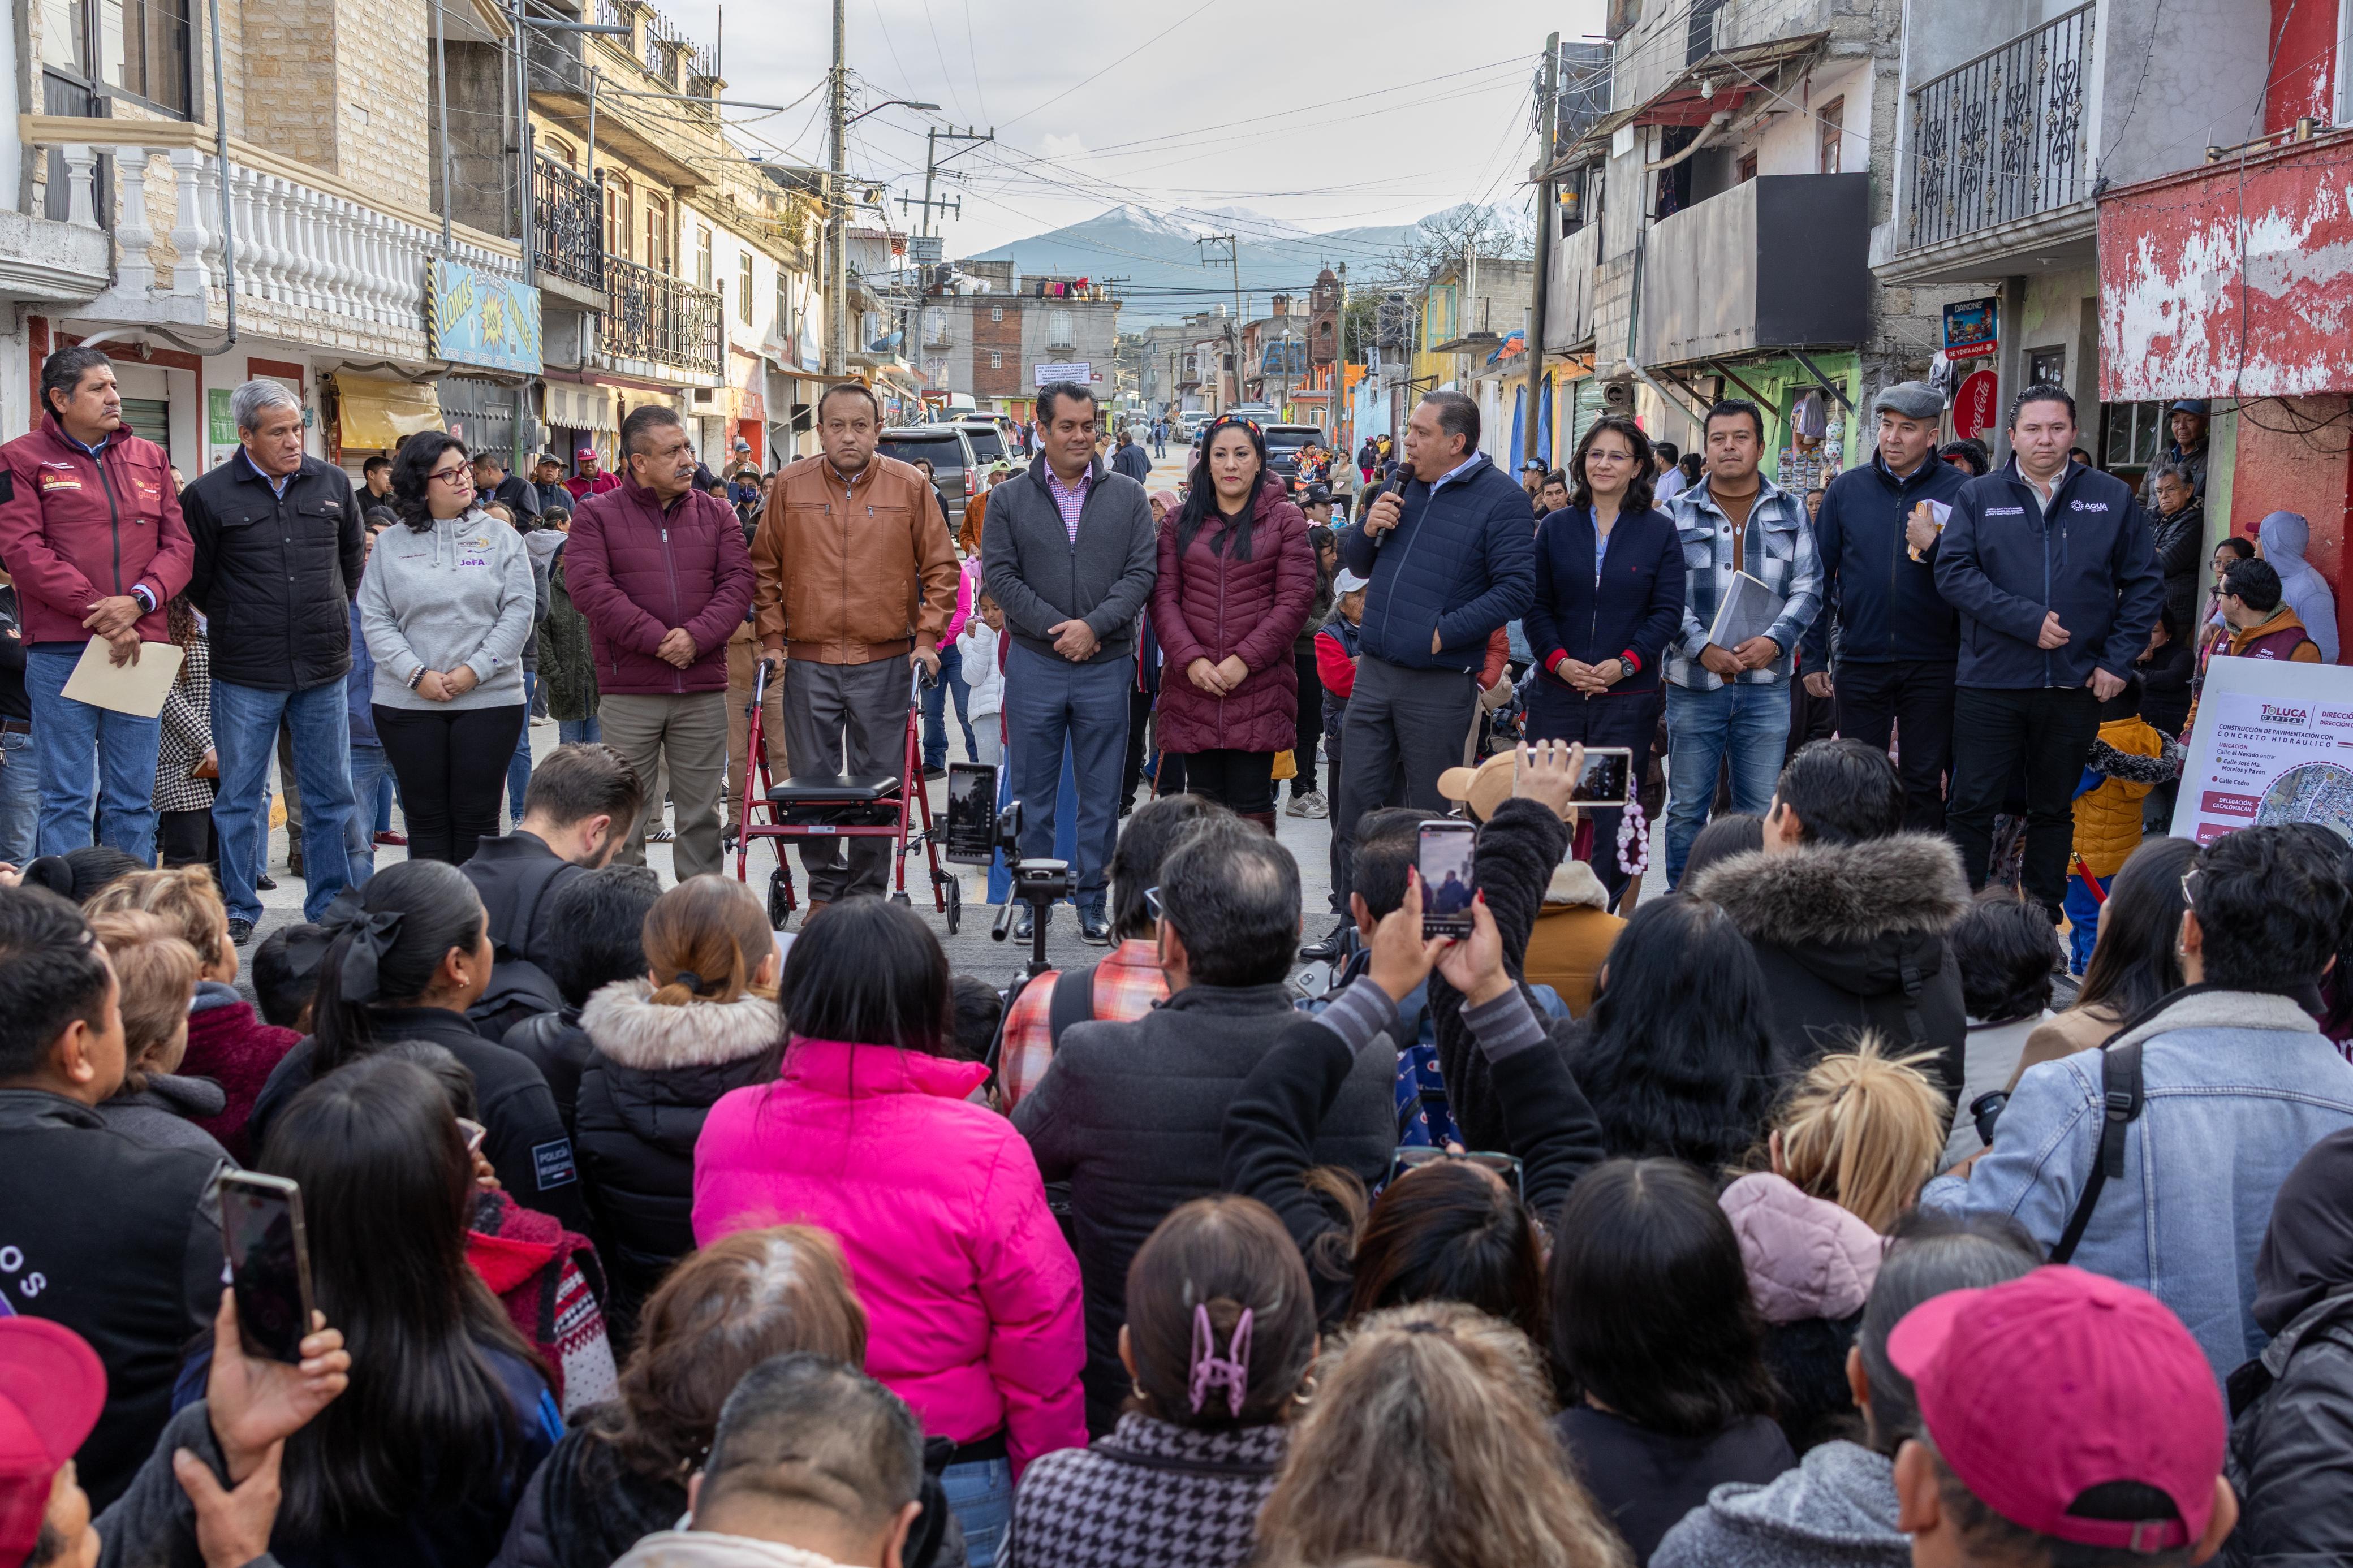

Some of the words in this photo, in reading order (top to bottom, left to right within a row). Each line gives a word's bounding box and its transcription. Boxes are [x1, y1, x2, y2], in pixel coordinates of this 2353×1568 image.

[441, 274, 473, 335] LONAS
[508, 287, 533, 355] VINILES
[1971, 344, 1984, 353] AQUÍ
[40, 474, 82, 483] TOLUCA
[2262, 704, 2307, 718] TOLUCA
[2218, 724, 2262, 733] CONSTRUCCIÓN
[2272, 729, 2320, 739] PAVIMENTACIÓN
[2217, 731, 2266, 741] CONCRETO
[2272, 736, 2331, 748] HIDRÁULICO
[2213, 803, 2252, 812] CACALOMACÁN
[2218, 797, 2253, 806] DELEGACIÓN:
[539, 1146, 568, 1163] POLICÍA
